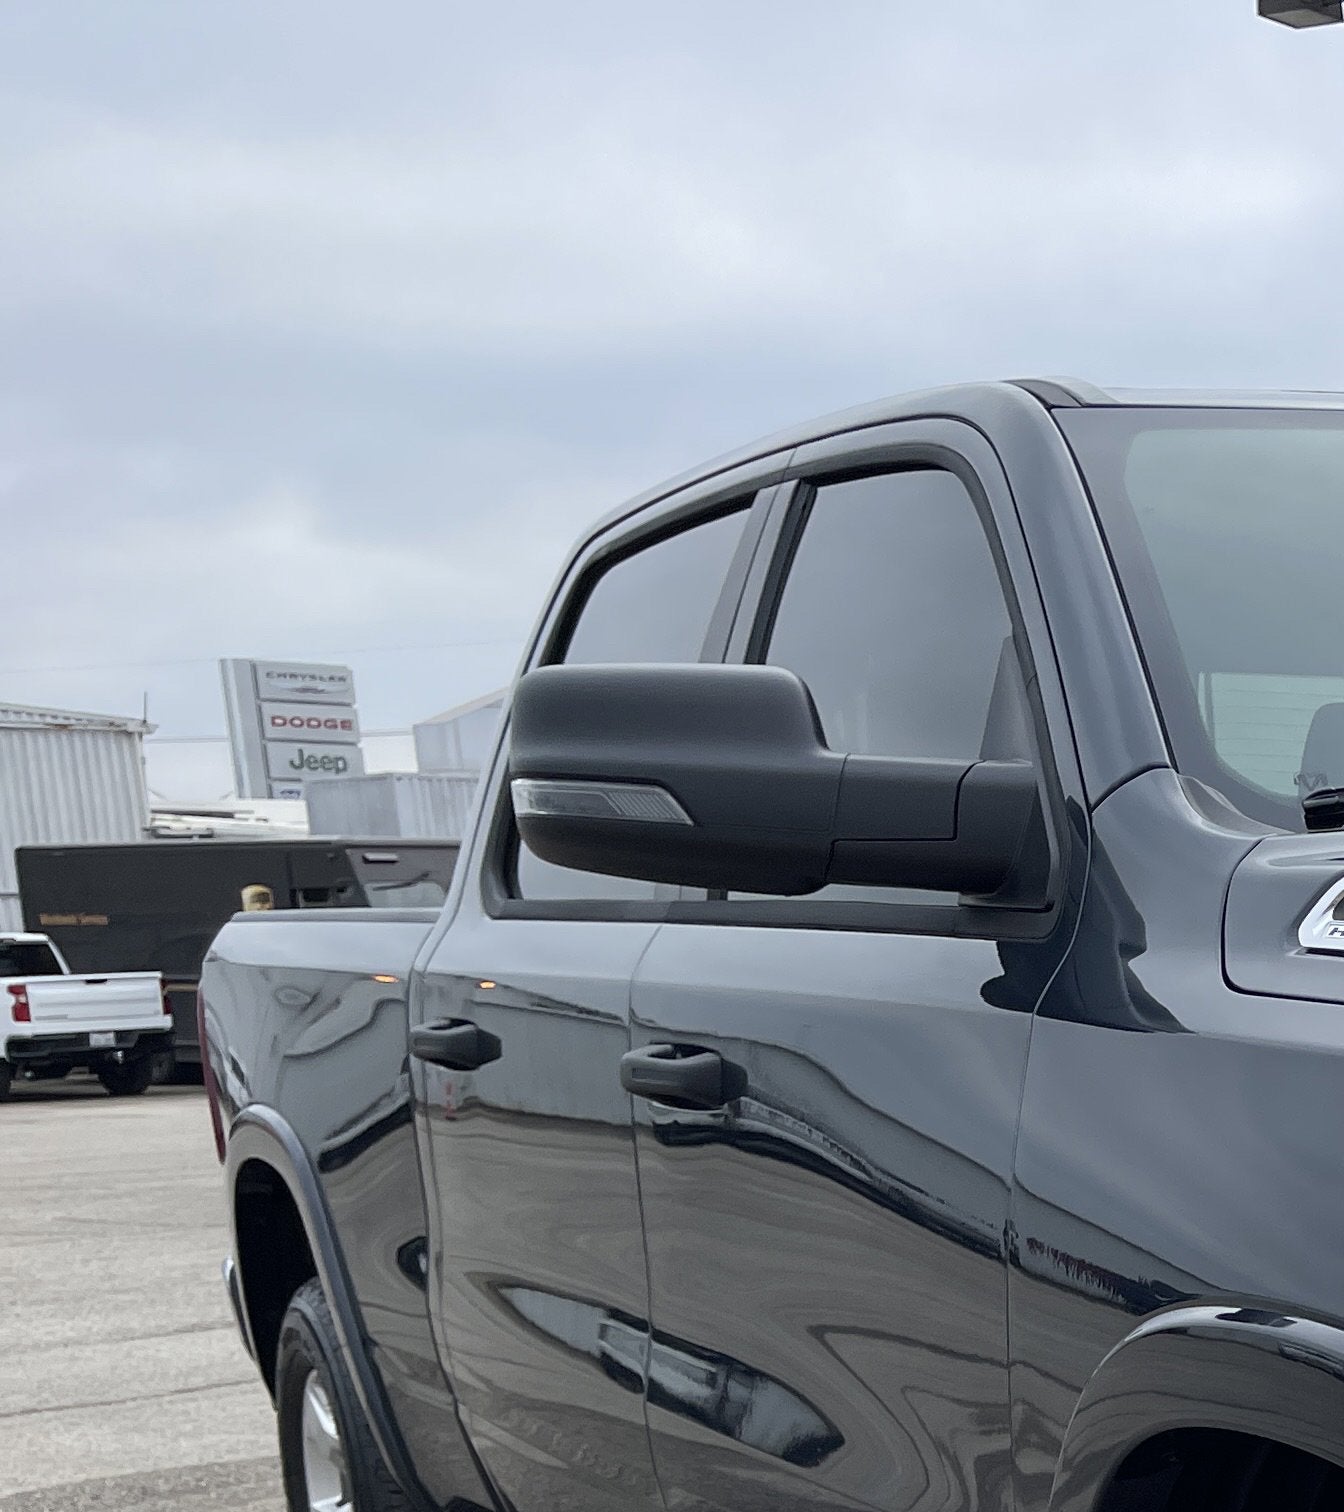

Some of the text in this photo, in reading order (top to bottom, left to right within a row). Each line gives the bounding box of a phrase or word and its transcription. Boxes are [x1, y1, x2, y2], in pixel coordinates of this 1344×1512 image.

[265, 671, 347, 682] CHRYSLER
[271, 715, 353, 731] DODGE
[289, 748, 348, 774] Jeep
